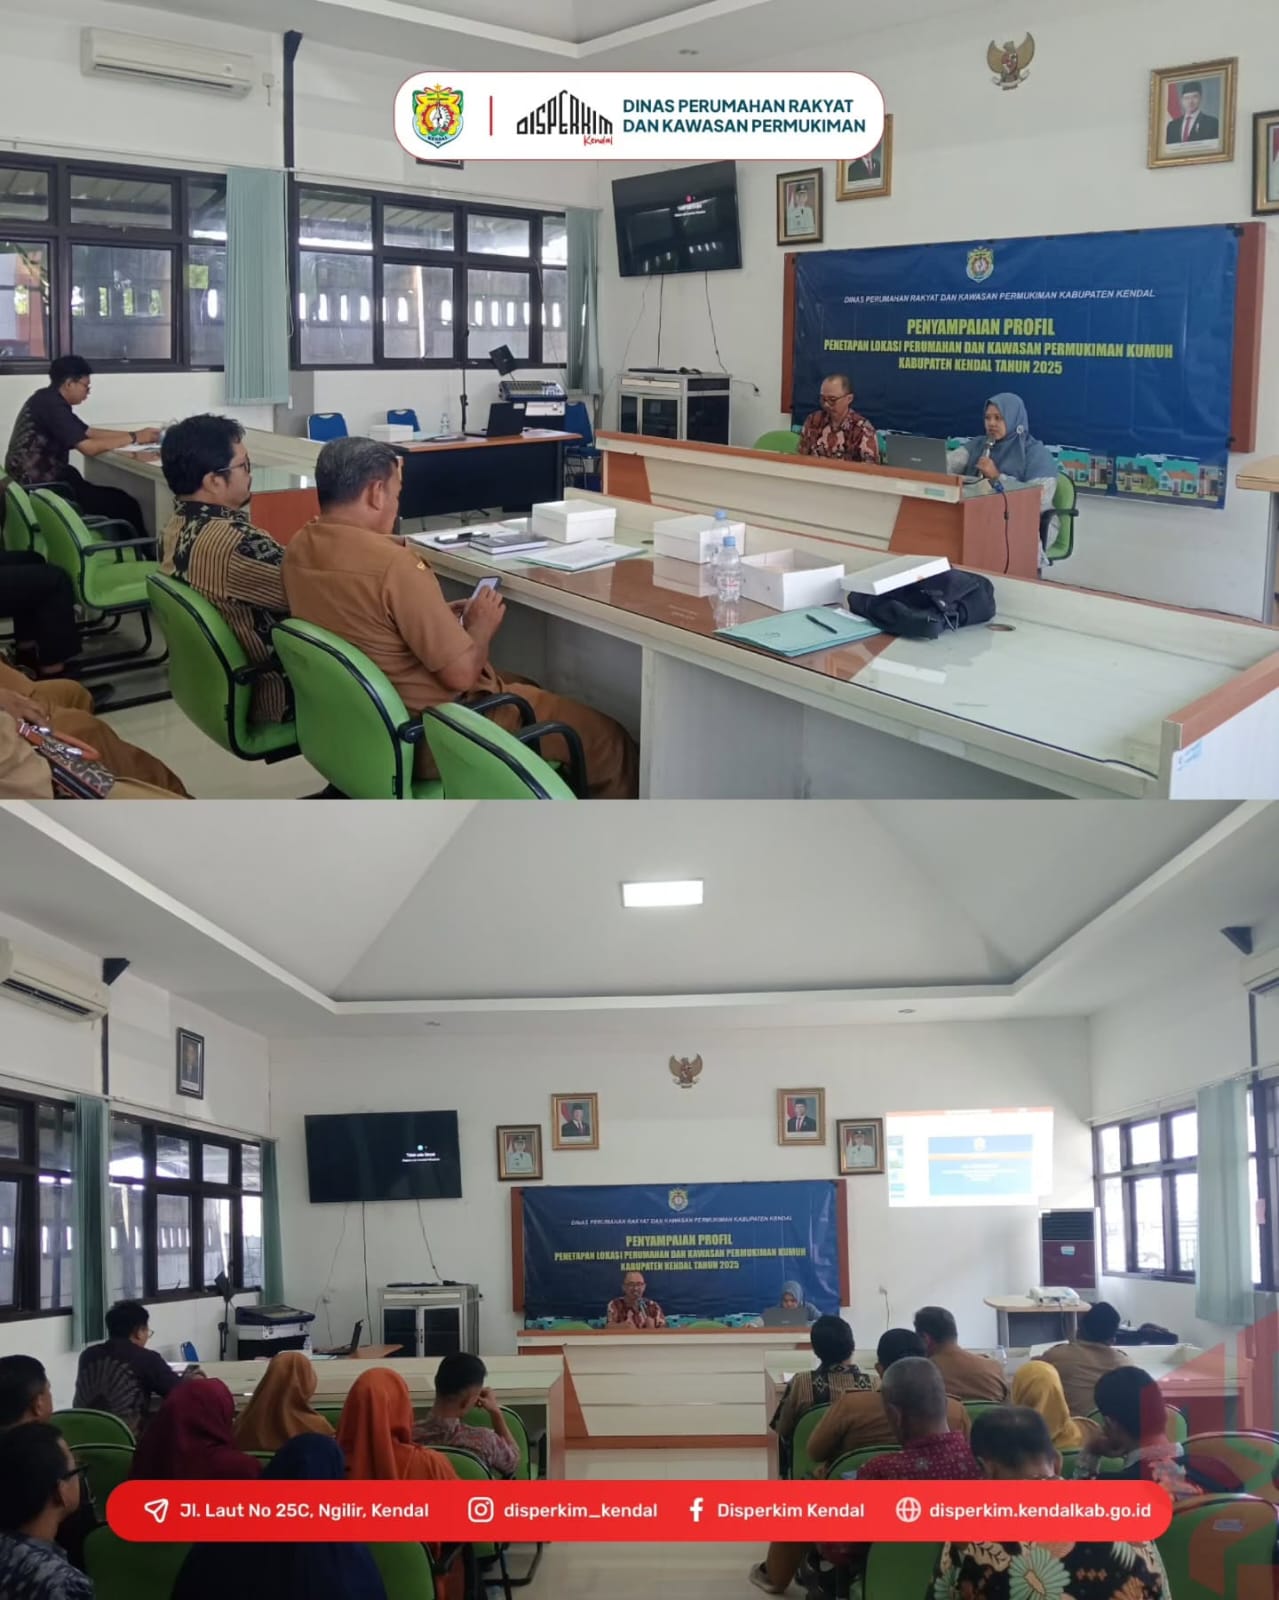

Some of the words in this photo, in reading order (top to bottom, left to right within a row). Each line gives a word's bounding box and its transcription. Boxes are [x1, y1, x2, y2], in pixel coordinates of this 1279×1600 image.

[844, 295, 865, 304] DINAS
[866, 294, 909, 303] PERUMAHAN
[910, 293, 939, 302] RAKYAT
[940, 293, 958, 301] DAN
[958, 292, 998, 301] KAWASAN
[999, 291, 1057, 300] PERMUKIMAN
[1059, 289, 1114, 299] KABUPATEN
[1115, 289, 1156, 298] KENDAL
[907, 318, 1001, 335] PENYAMPAIAN
[1003, 318, 1056, 336] PROFIL
[824, 339, 869, 352] PENETAPAN
[870, 339, 902, 352] LOKASI
[903, 340, 963, 354] PERUMAHAN
[964, 341, 985, 354] DAN
[987, 341, 1042, 355] KAWASAN
[1044, 342, 1124, 358] PERMUKIMAN
[1126, 343, 1174, 358] KUMUH
[898, 356, 952, 371] KABUPATEN
[954, 358, 993, 372] KENDAL
[995, 359, 1031, 374] TAHUN
[1033, 360, 1063, 375] 2025
[625, 1234, 697, 1247] PENYAMPAIAN
[698, 1233, 733, 1246] PROFIL
[554, 1251, 595, 1261] PENETAPAN
[596, 1251, 623, 1260] LOKASI
[624, 1250, 670, 1259] PERUMAHAN
[671, 1249, 687, 1259] DAN
[687, 1249, 725, 1258] KAWASAN
[726, 1248, 777, 1257] PERMUKIMAN
[620, 1262, 663, 1271] KABUPATEN
[664, 1261, 692, 1270] KENDAL
[693, 1261, 719, 1270] TAHUN
[719, 1260, 740, 1270] 2025
